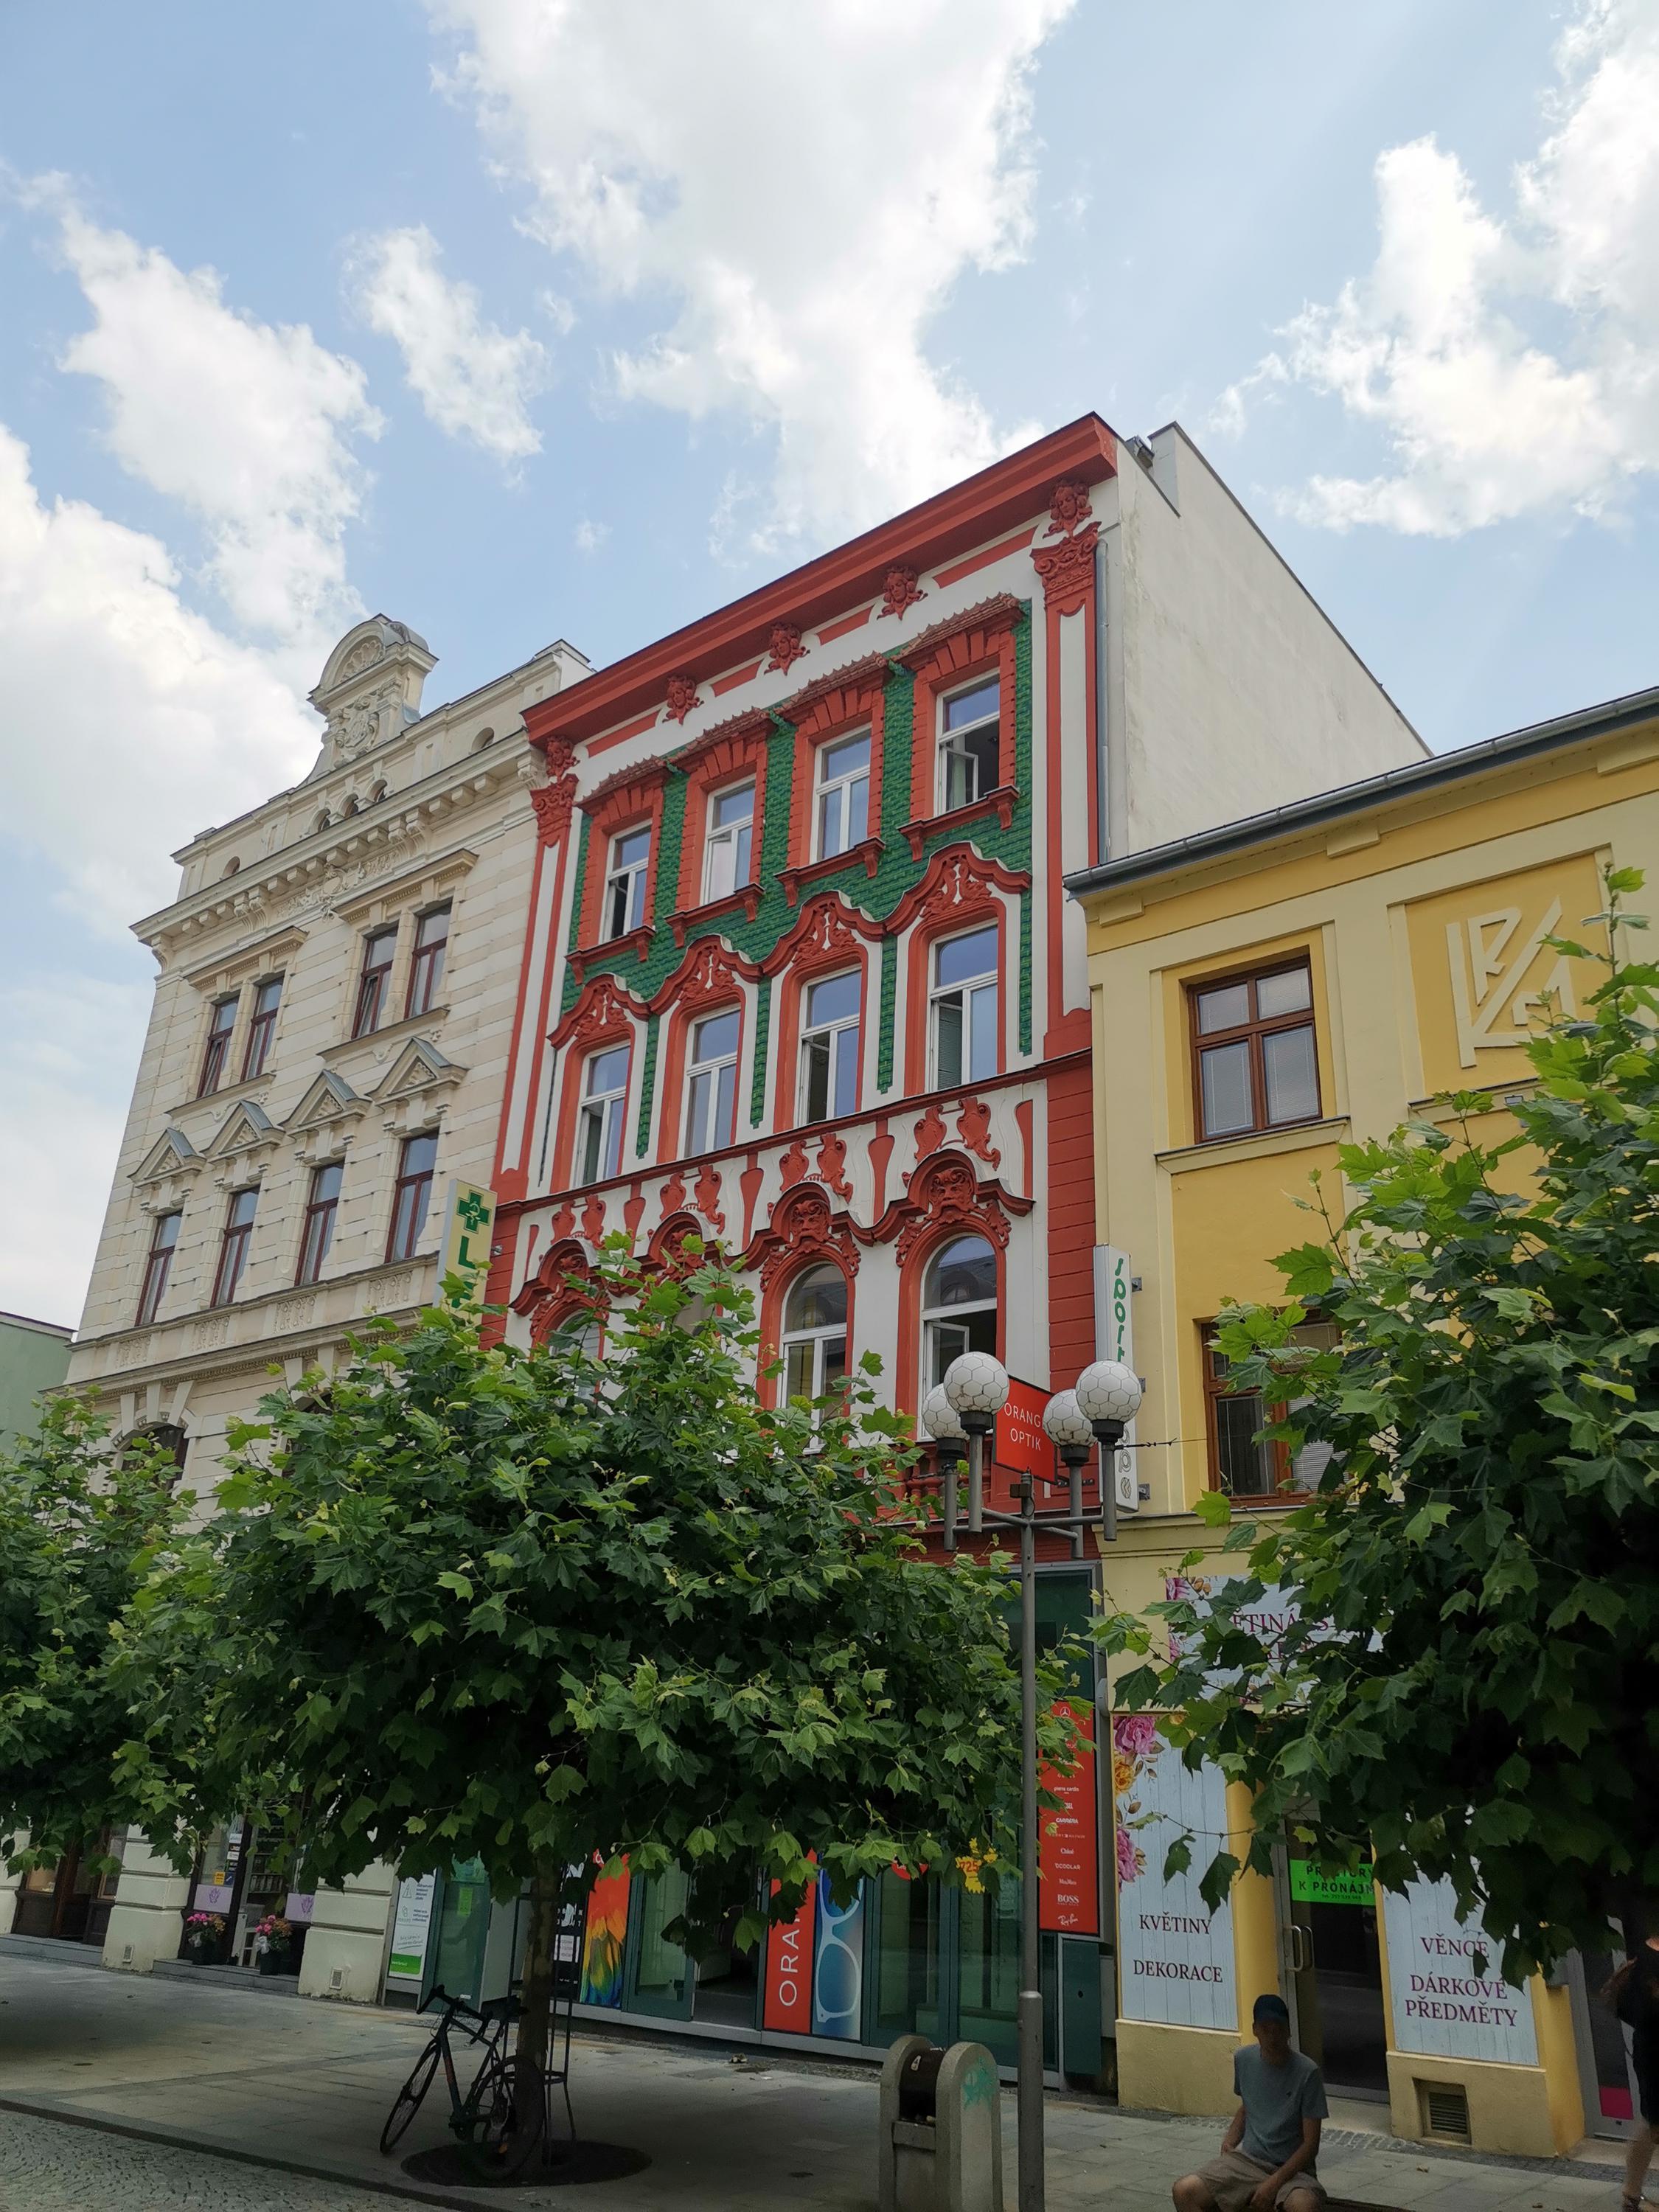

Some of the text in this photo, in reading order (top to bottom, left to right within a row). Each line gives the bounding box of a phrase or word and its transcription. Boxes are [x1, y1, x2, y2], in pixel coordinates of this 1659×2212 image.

[1004, 1402, 1041, 1427] ORANG
[1010, 1427, 1041, 1452] OPTIK
[1057, 1894, 1079, 1904] BOSS
[1298, 1880, 1375, 1894] K PRONÁJM
[1138, 1911, 1211, 1935] KVĚTINY
[1420, 1932, 1489, 1959] VĚNCE
[779, 1916, 801, 2006] ORA
[1133, 1959, 1223, 1983] DEKORACE
[1410, 1971, 1508, 2000] DÁRKOVÉ
[1405, 1995, 1517, 2027] PŘEDMĚTY
